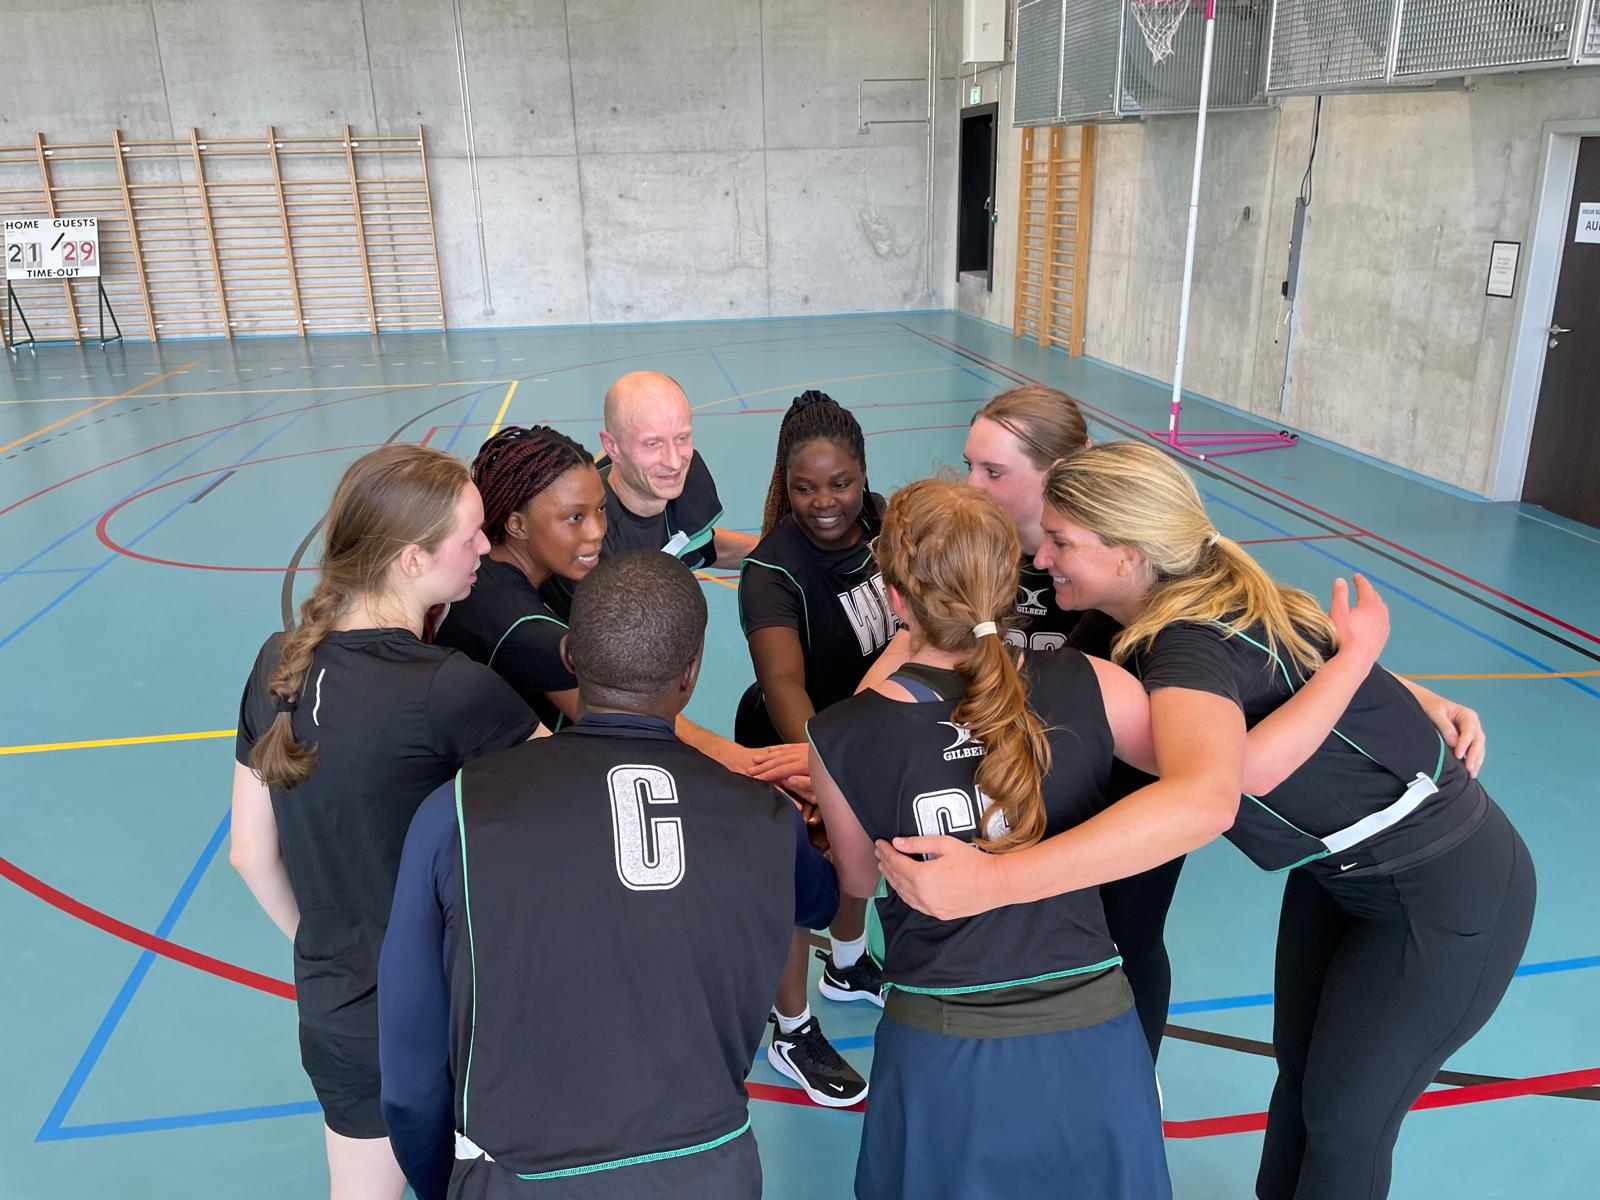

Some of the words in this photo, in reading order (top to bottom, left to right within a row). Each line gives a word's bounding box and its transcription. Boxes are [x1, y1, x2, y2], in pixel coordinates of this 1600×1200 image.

[6, 220, 39, 230] HOME
[53, 218, 95, 228] GUESTS
[1585, 220, 1600, 231] AU
[8, 243, 37, 263] 21
[63, 241, 93, 261] 29
[27, 268, 80, 278] TIME-OUT
[1016, 606, 1048, 616] GILBERT
[943, 746, 986, 761] GILBER
[606, 764, 686, 891] C
